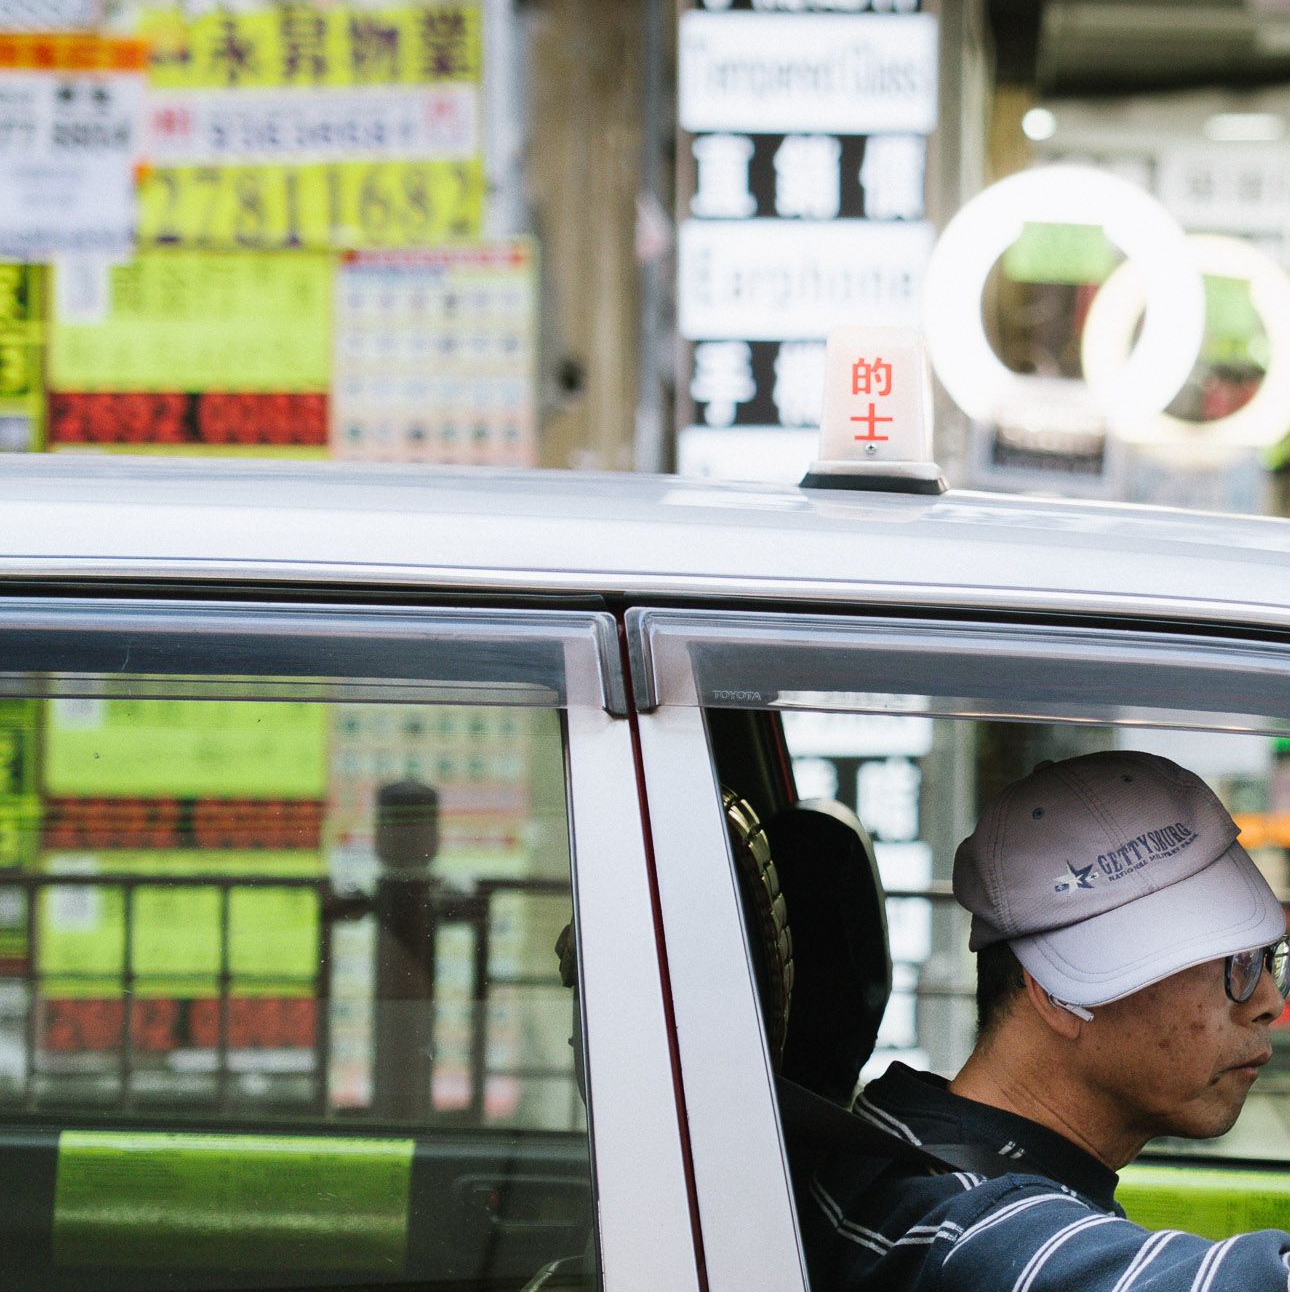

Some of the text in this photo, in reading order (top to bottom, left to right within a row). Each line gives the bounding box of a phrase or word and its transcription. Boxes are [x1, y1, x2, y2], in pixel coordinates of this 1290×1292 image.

[850, 357, 894, 442] 的士
[713, 690, 762, 701] TOYOTA
[1097, 822, 1192, 875] GETTYSBURG
[1108, 859, 1148, 882] NATIONAL
